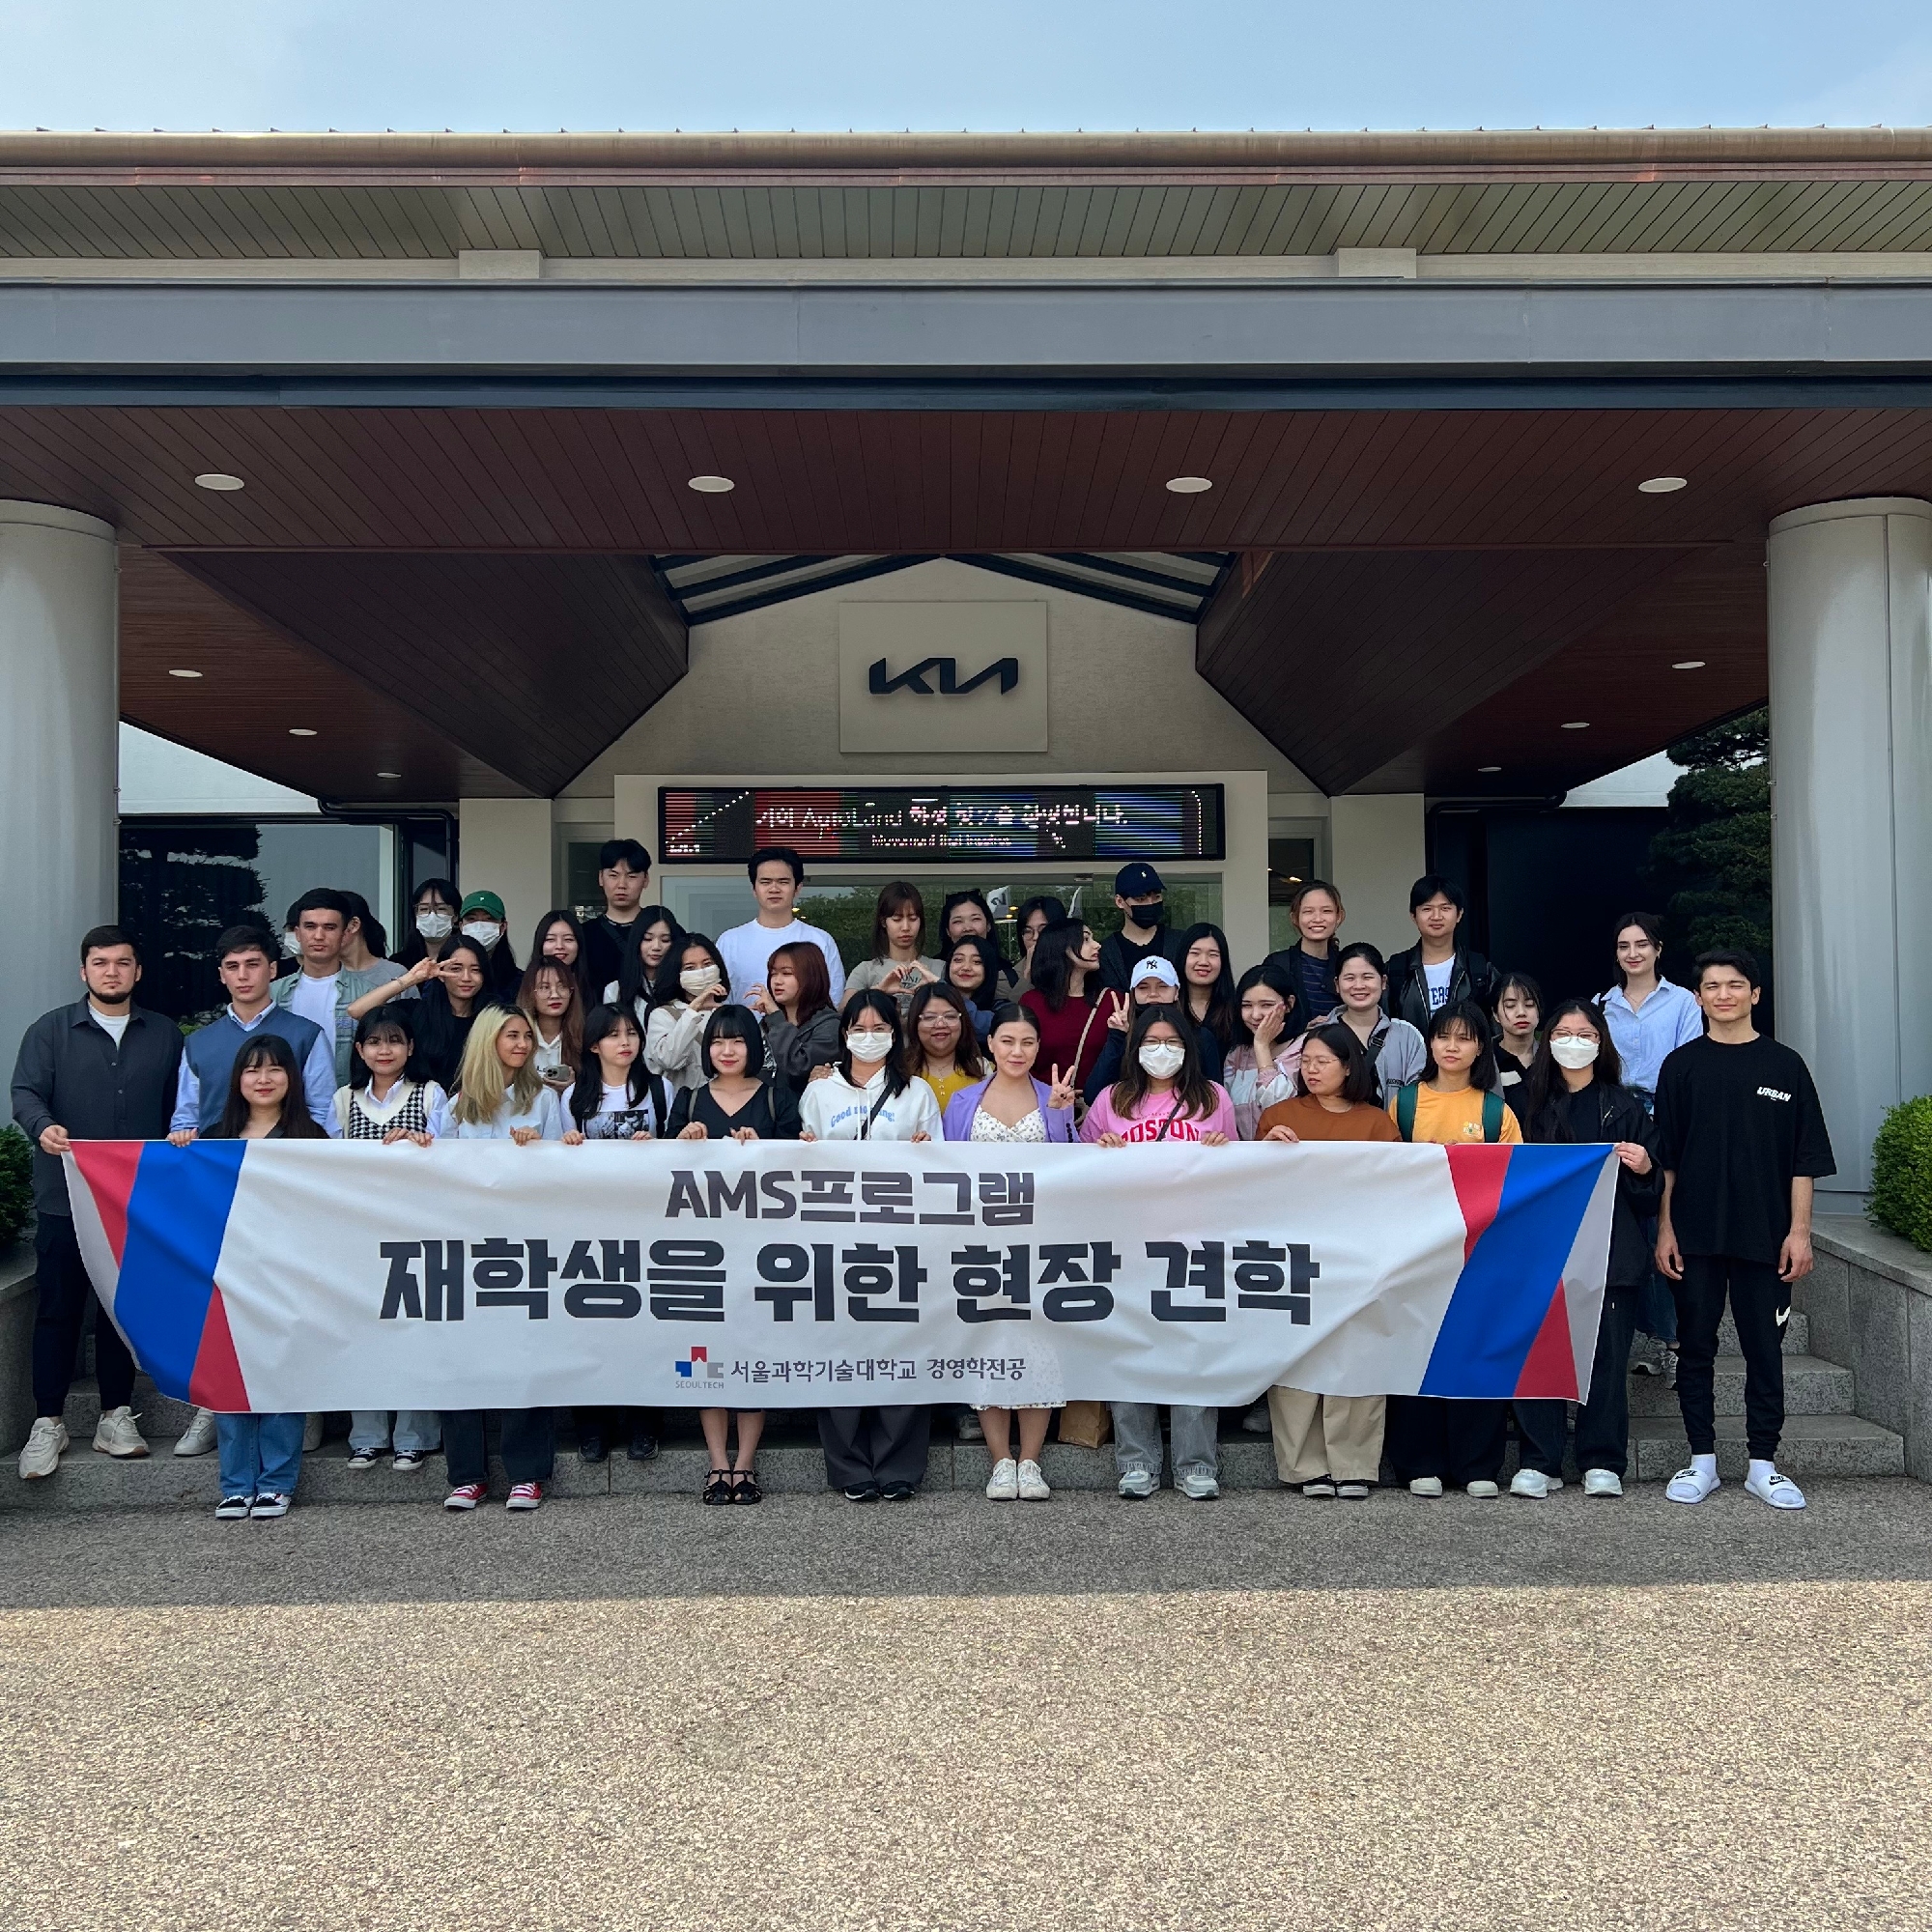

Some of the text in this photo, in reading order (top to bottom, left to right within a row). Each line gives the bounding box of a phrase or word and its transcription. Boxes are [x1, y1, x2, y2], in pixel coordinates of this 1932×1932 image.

[1756, 1086, 1792, 1102] URBAN
[831, 1106, 852, 1128] Good
[1121, 1118, 1201, 1143] OSON
[665, 1170, 1035, 1227] AMS프로그램
[379, 1237, 1321, 1326] 재학생을 위한 현장 견학
[730, 1357, 1027, 1383] 서울과학기술대학교 경영학전공
[675, 1380, 724, 1389] SEOULTECH
